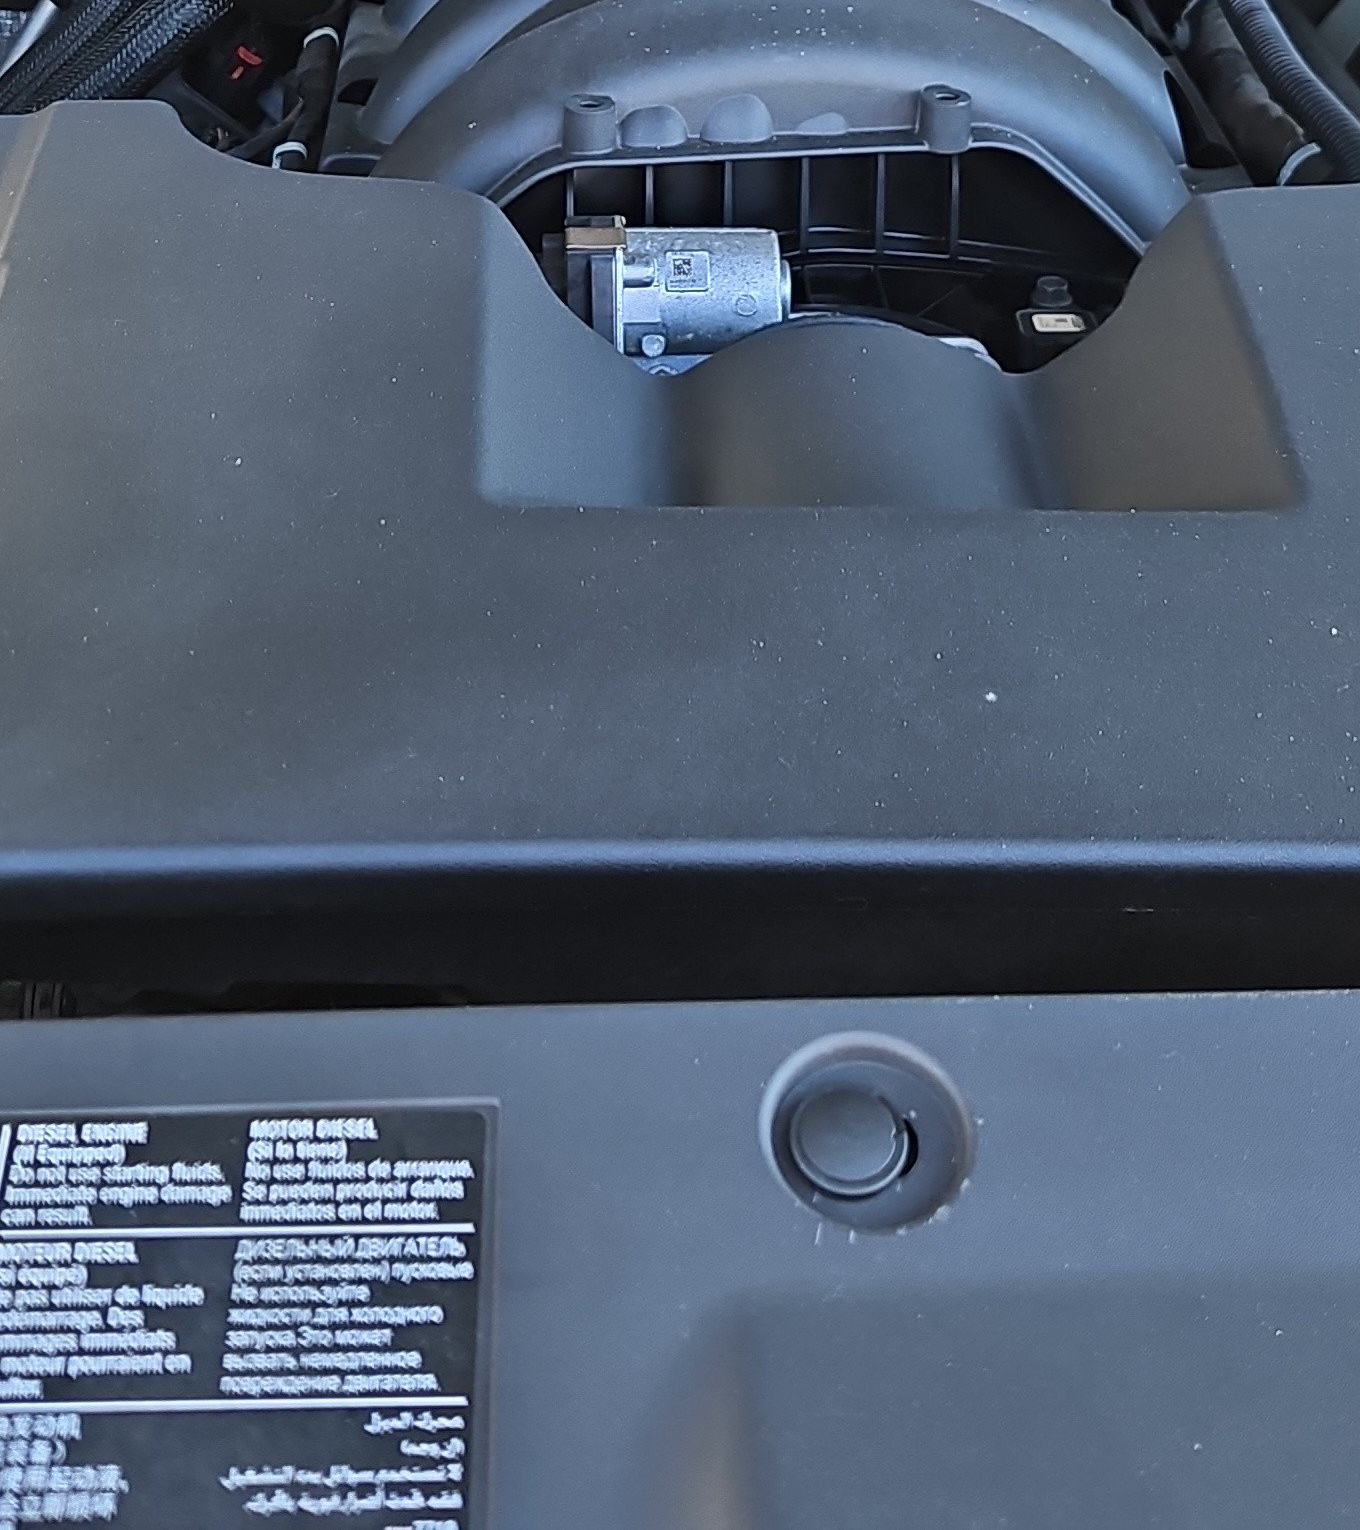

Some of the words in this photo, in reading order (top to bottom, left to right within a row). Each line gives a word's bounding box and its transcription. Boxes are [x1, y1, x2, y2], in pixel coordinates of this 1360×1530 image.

[17, 1123, 78, 1144] DIESEL
[81, 1122, 149, 1144] ENGINE
[249, 1119, 314, 1140] MOTOR
[315, 1118, 379, 1140] DIESEL
[68, 1166, 101, 1184] use
[272, 1163, 305, 1180] use
[367, 1158, 391, 1179] de
[99, 1184, 159, 1208] engine
[160, 1183, 232, 1207] damage
[73, 1241, 139, 1263] DIESEL
[114, 1284, 140, 1307] de
